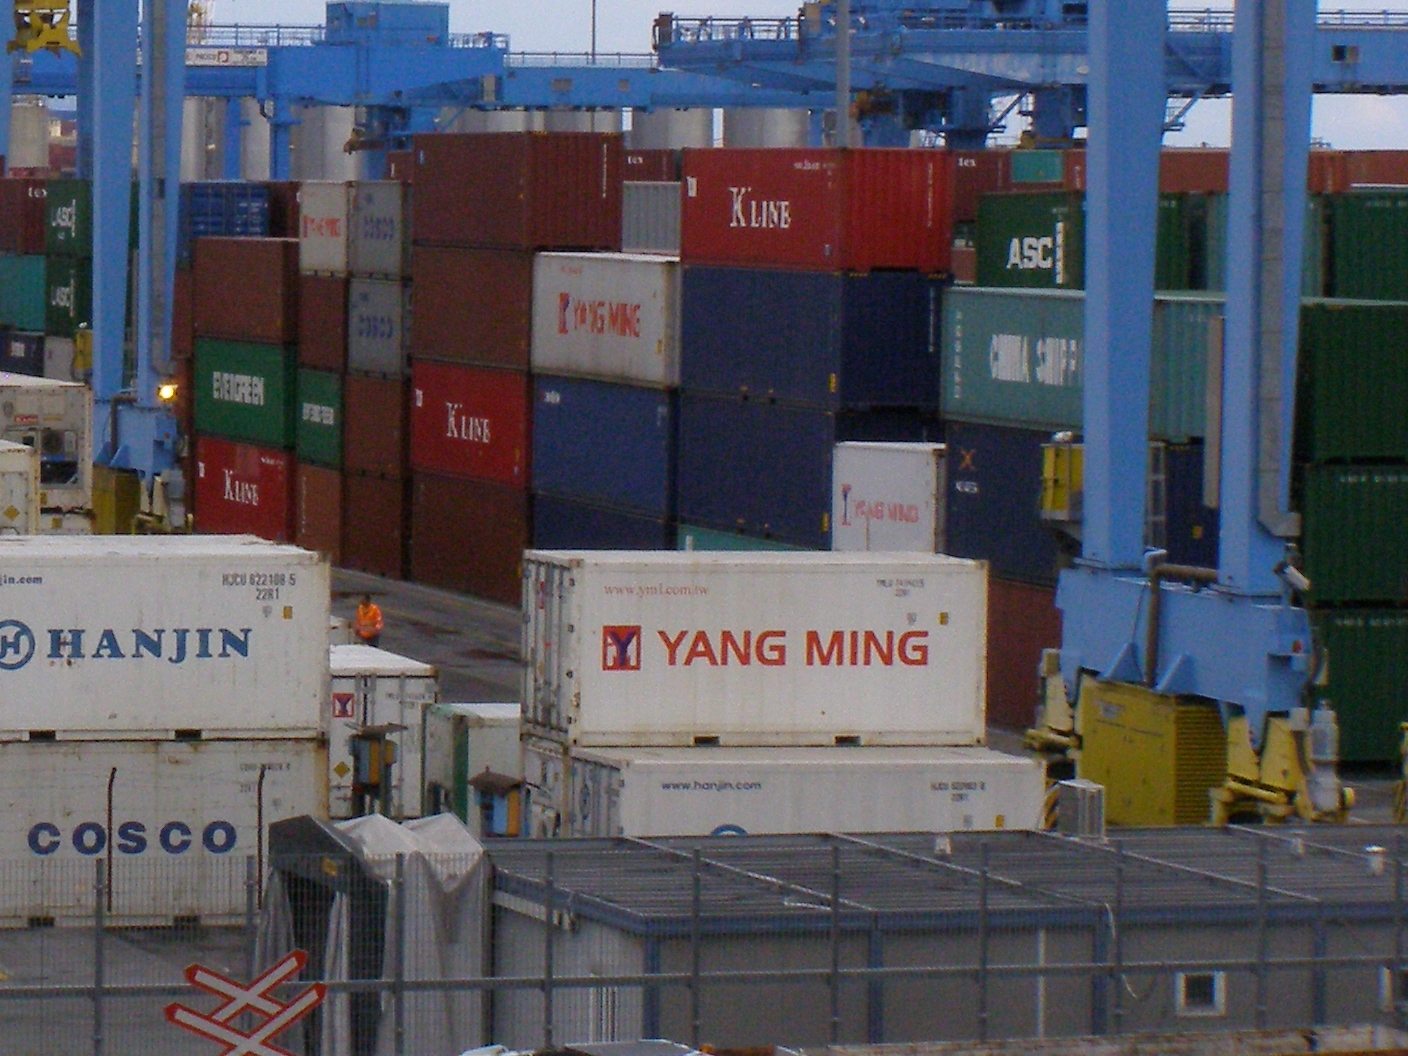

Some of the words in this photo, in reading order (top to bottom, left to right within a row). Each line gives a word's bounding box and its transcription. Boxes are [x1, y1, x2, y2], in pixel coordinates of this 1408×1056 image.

[47, 628, 253, 664] HANJIN
[657, 630, 787, 666] YANG
[805, 630, 930, 666] MING
[660, 779, 763, 793] www.hanjin.com
[27, 820, 238, 856] COSCO
